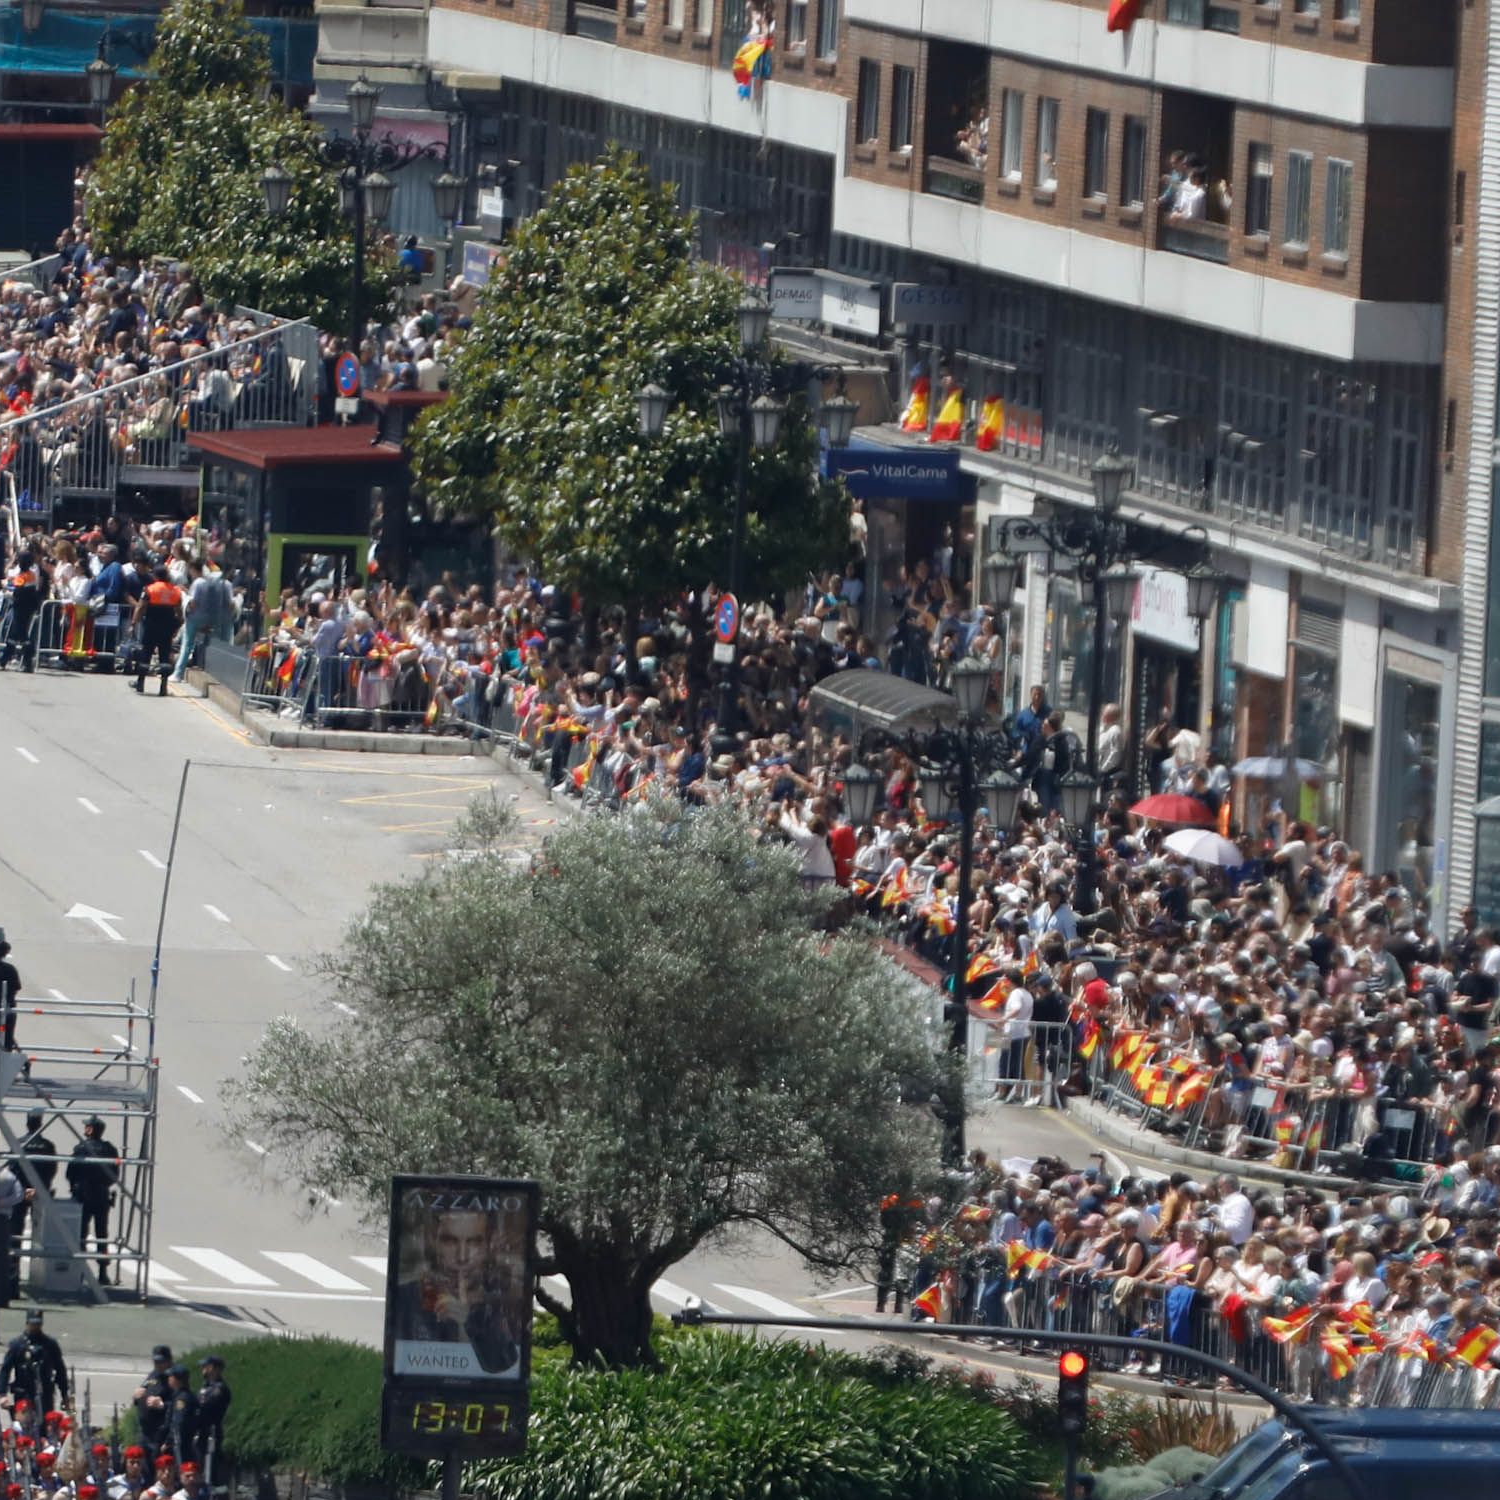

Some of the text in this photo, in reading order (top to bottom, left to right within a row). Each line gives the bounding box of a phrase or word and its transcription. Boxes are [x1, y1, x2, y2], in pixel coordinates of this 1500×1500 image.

[775, 287, 814, 300] DEMAG
[872, 464, 948, 479] VitalCama
[408, 1192, 522, 1212] AZZARO
[407, 1353, 470, 1370] WANTED
[412, 1402, 510, 1434] 13:07
